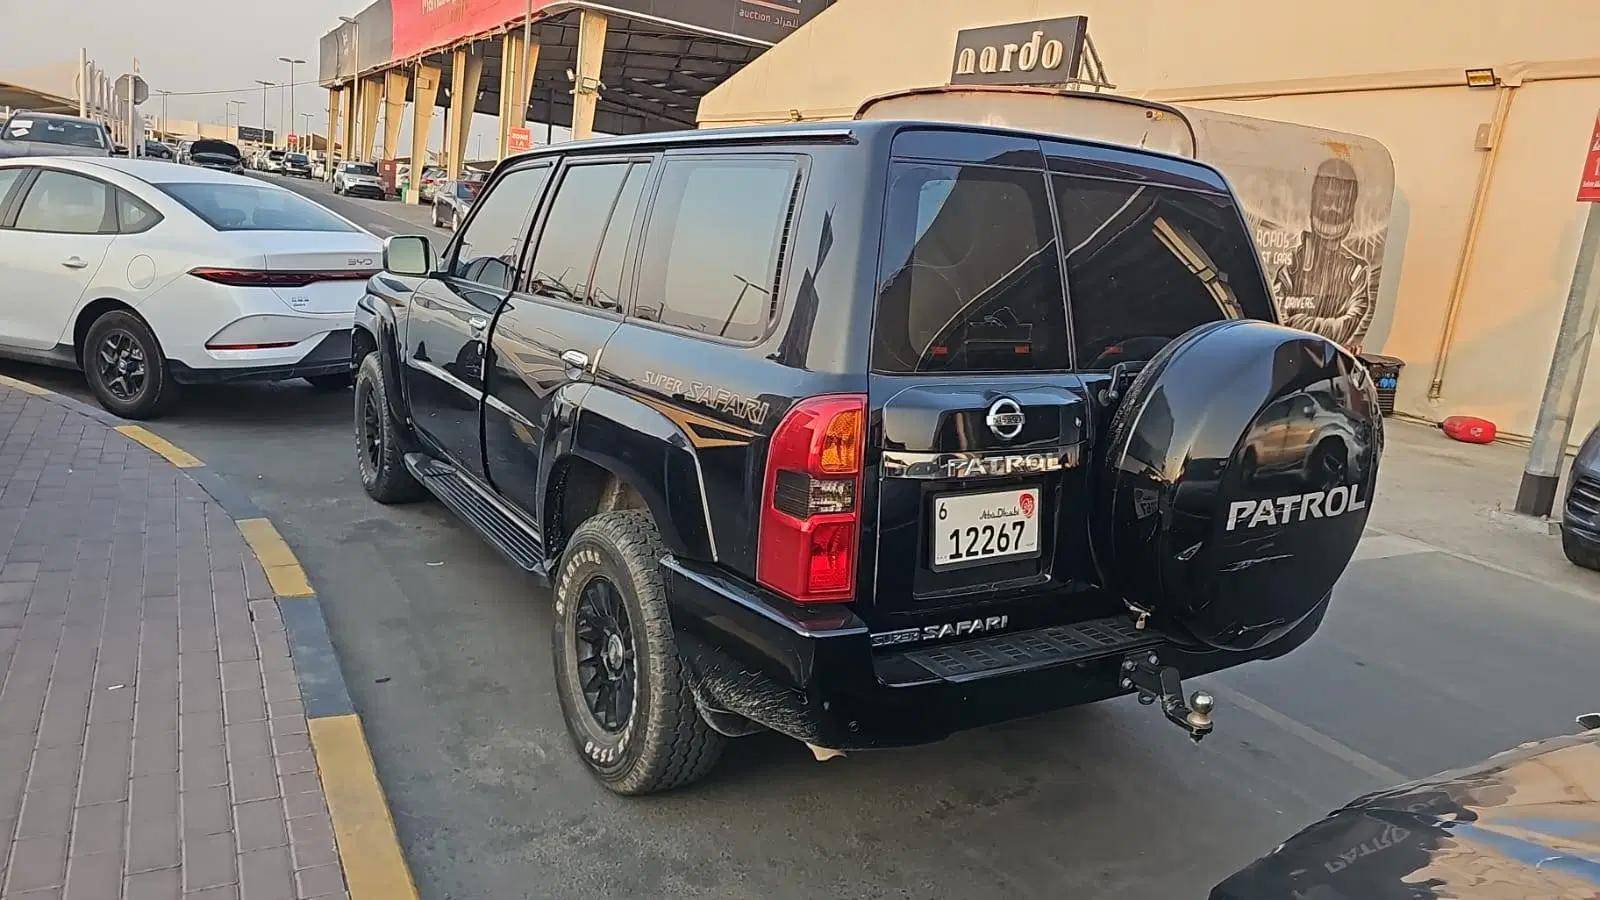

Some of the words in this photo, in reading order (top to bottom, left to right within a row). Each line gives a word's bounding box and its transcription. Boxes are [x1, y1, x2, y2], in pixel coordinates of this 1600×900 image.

[739, 9, 771, 22] auction
[955, 31, 1064, 74] nardo
[347, 258, 374, 266] BYD
[642, 370, 683, 394] SUPER
[684, 380, 770, 425] SAFARI
[947, 452, 1063, 478] PATROL
[939, 502, 948, 520] 6
[1225, 484, 1367, 531] PATROL
[948, 520, 1026, 560] 12267
[922, 615, 1009, 641] SAFARI
